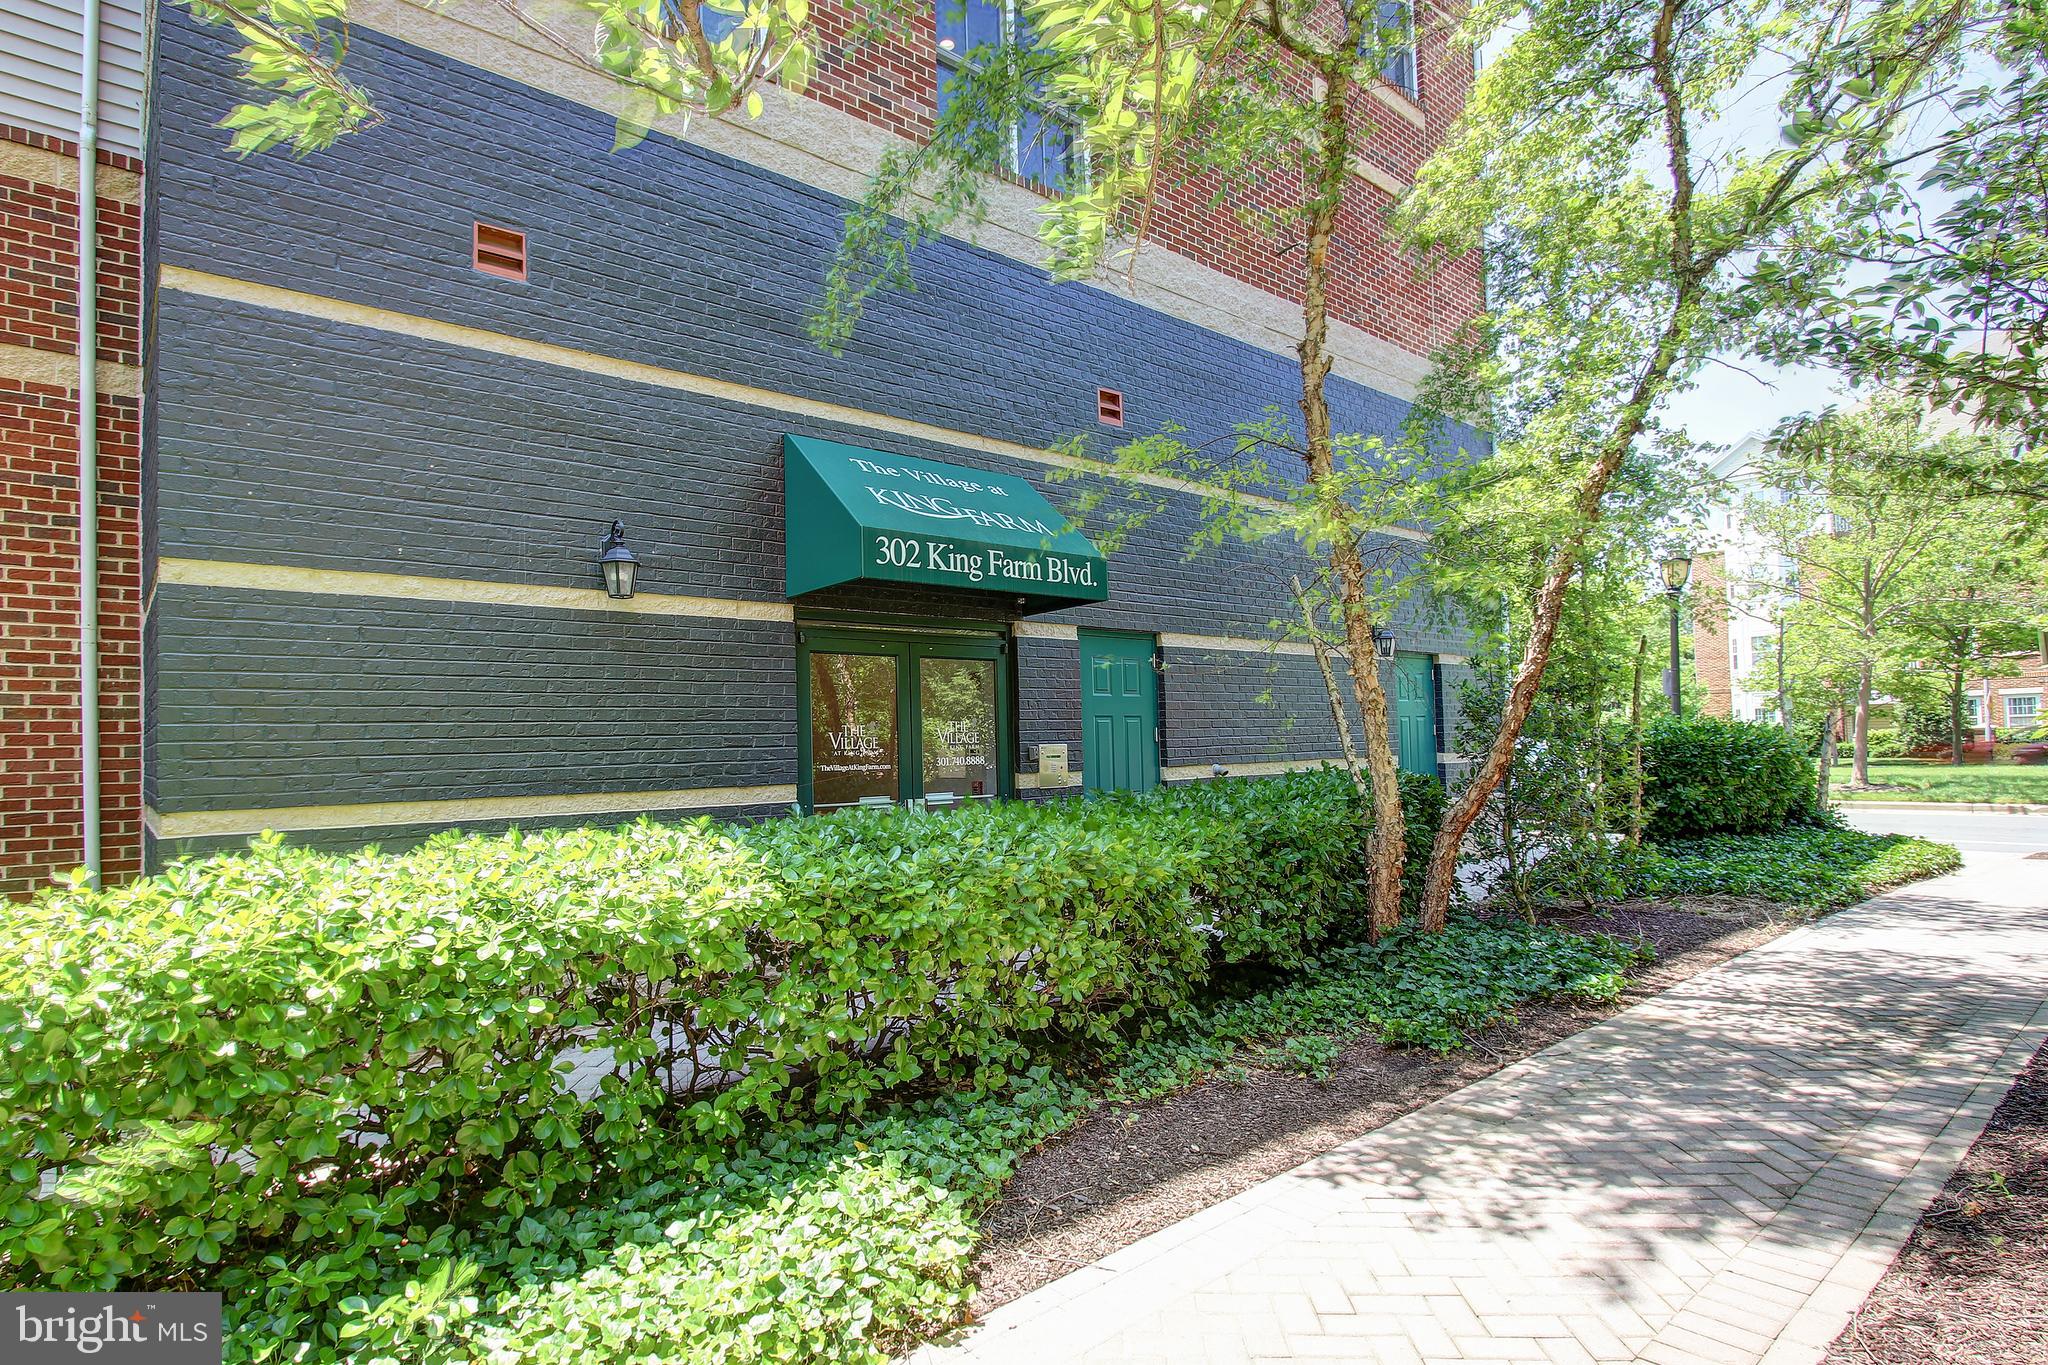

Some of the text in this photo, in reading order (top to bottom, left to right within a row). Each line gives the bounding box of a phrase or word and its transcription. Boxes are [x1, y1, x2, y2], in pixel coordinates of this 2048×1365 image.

[849, 457, 1009, 497] The Village at
[963, 509, 1054, 537] FARM
[875, 536, 1098, 587] 302 King Farm Blvd.
[841, 724, 866, 737] THE
[949, 720, 968, 732] THE
[828, 731, 879, 750] VILLAGE
[936, 728, 980, 744] VILLAGE
[936, 755, 985, 767] 301.740.8888
